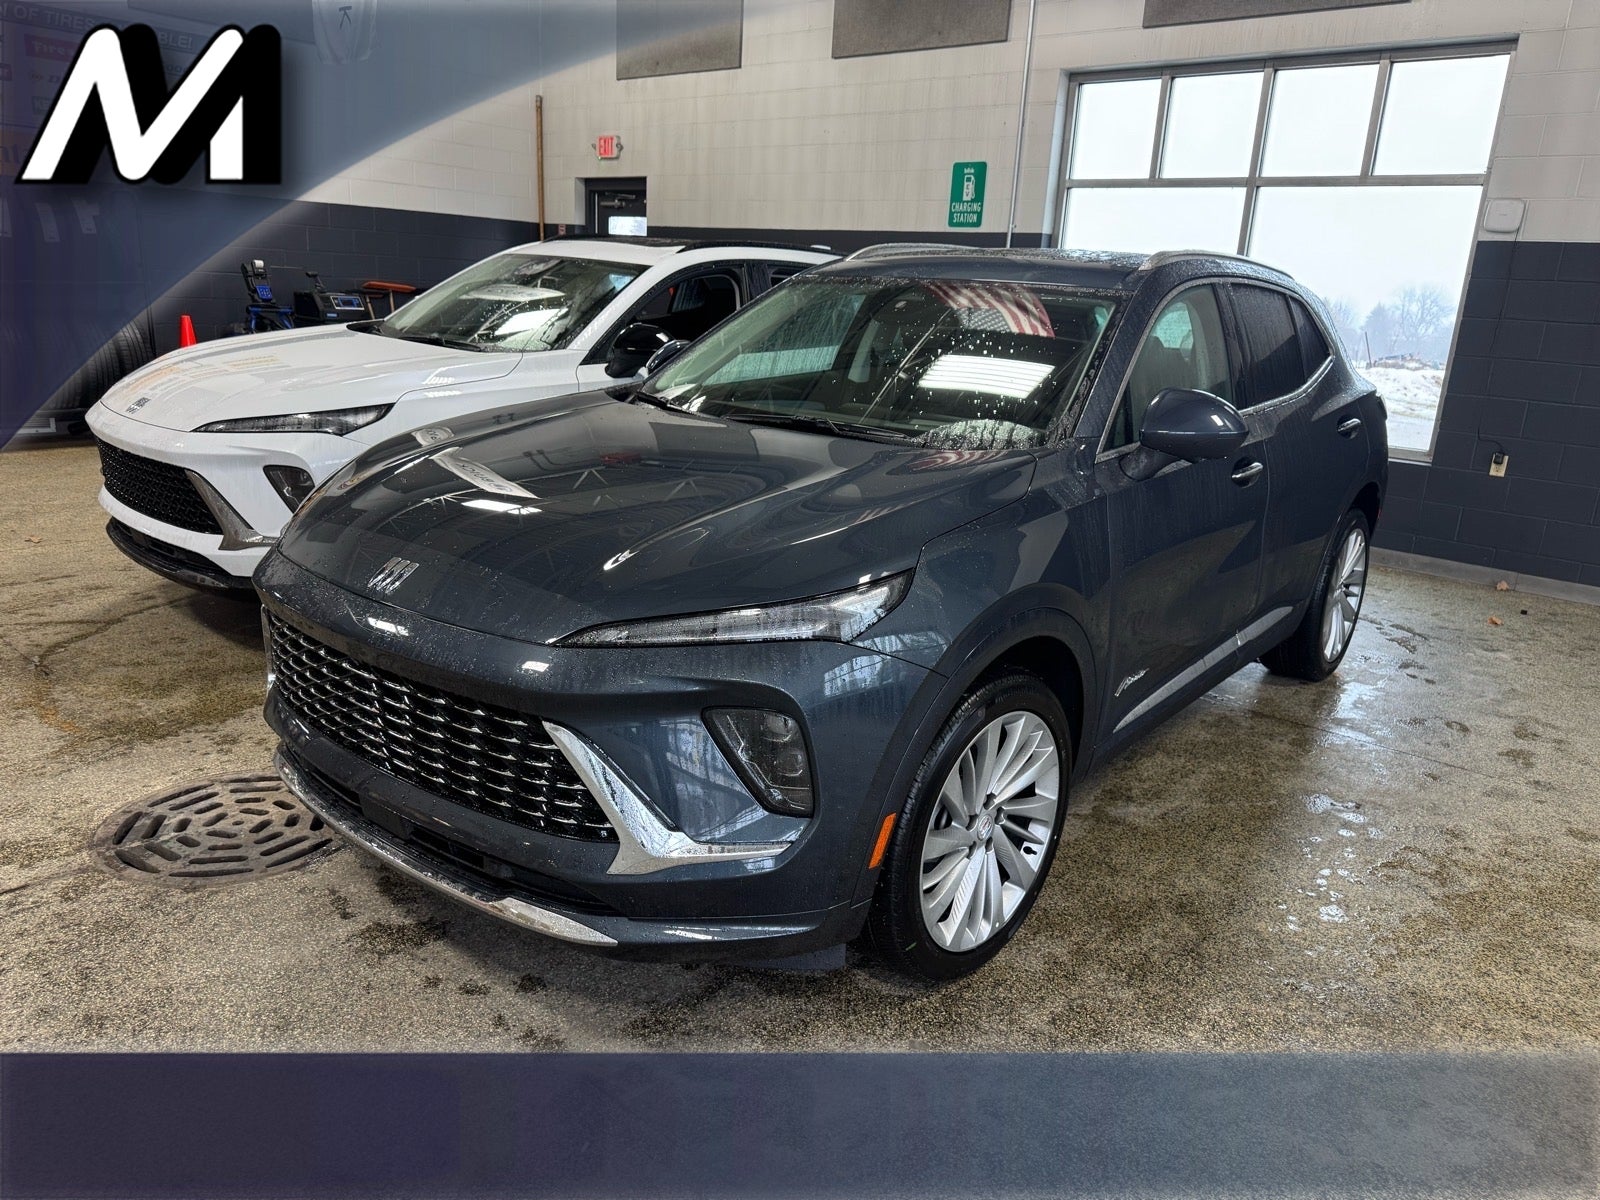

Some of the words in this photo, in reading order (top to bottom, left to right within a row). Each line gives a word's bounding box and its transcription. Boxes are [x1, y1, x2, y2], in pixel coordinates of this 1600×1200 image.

[14, 5, 39, 20] OF
[44, 10, 96, 30] TIRES
[598, 136, 614, 156] EXIT
[951, 202, 982, 212] CHARGING
[953, 213, 978, 223] STATION
